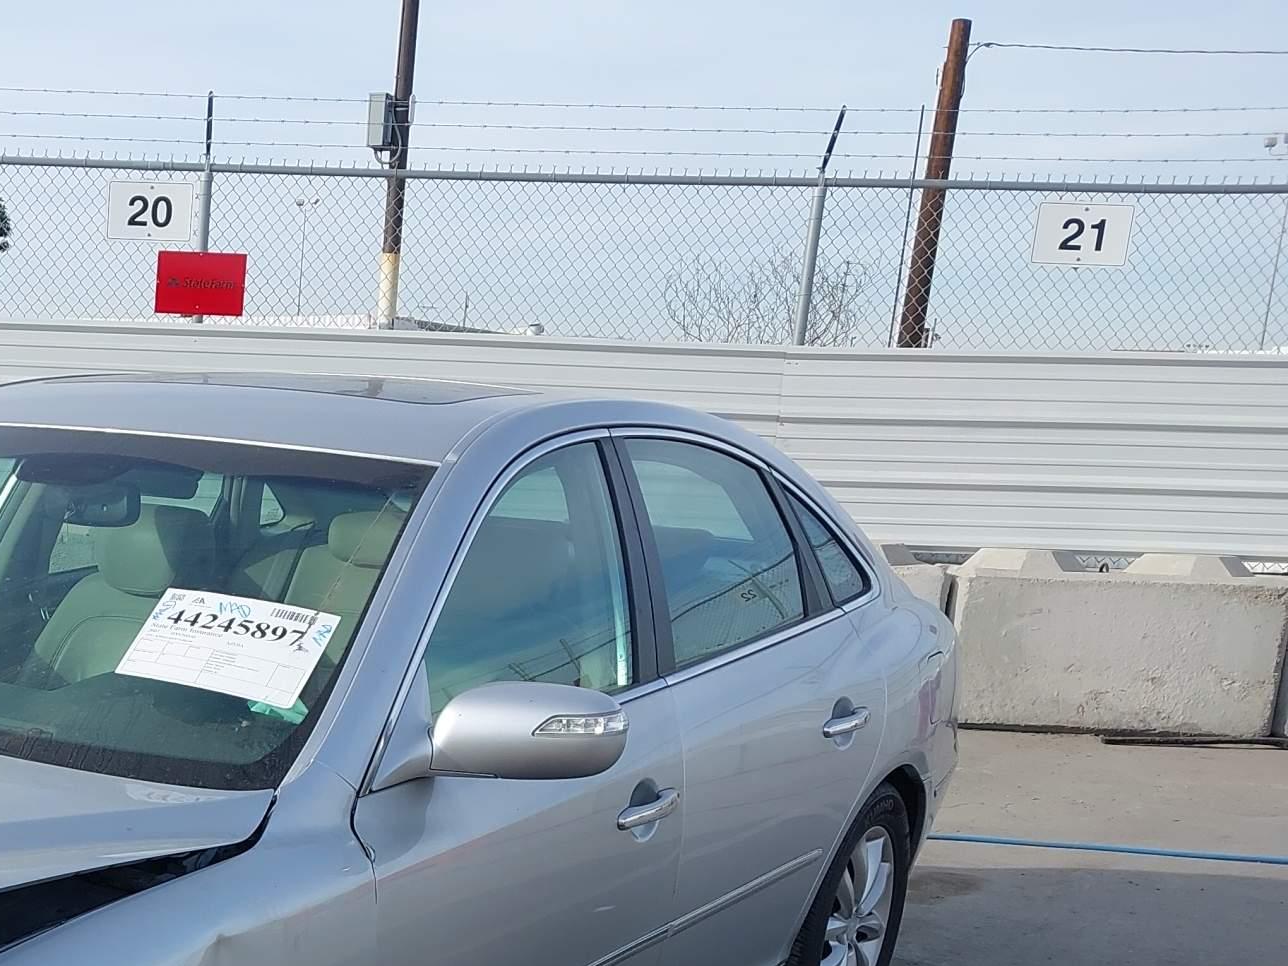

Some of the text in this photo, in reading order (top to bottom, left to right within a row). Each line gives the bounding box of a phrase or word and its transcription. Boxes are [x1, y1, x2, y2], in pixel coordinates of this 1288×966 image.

[127, 195, 173, 228] 20
[1058, 218, 1107, 252] 21
[167, 609, 308, 647] 44245897
